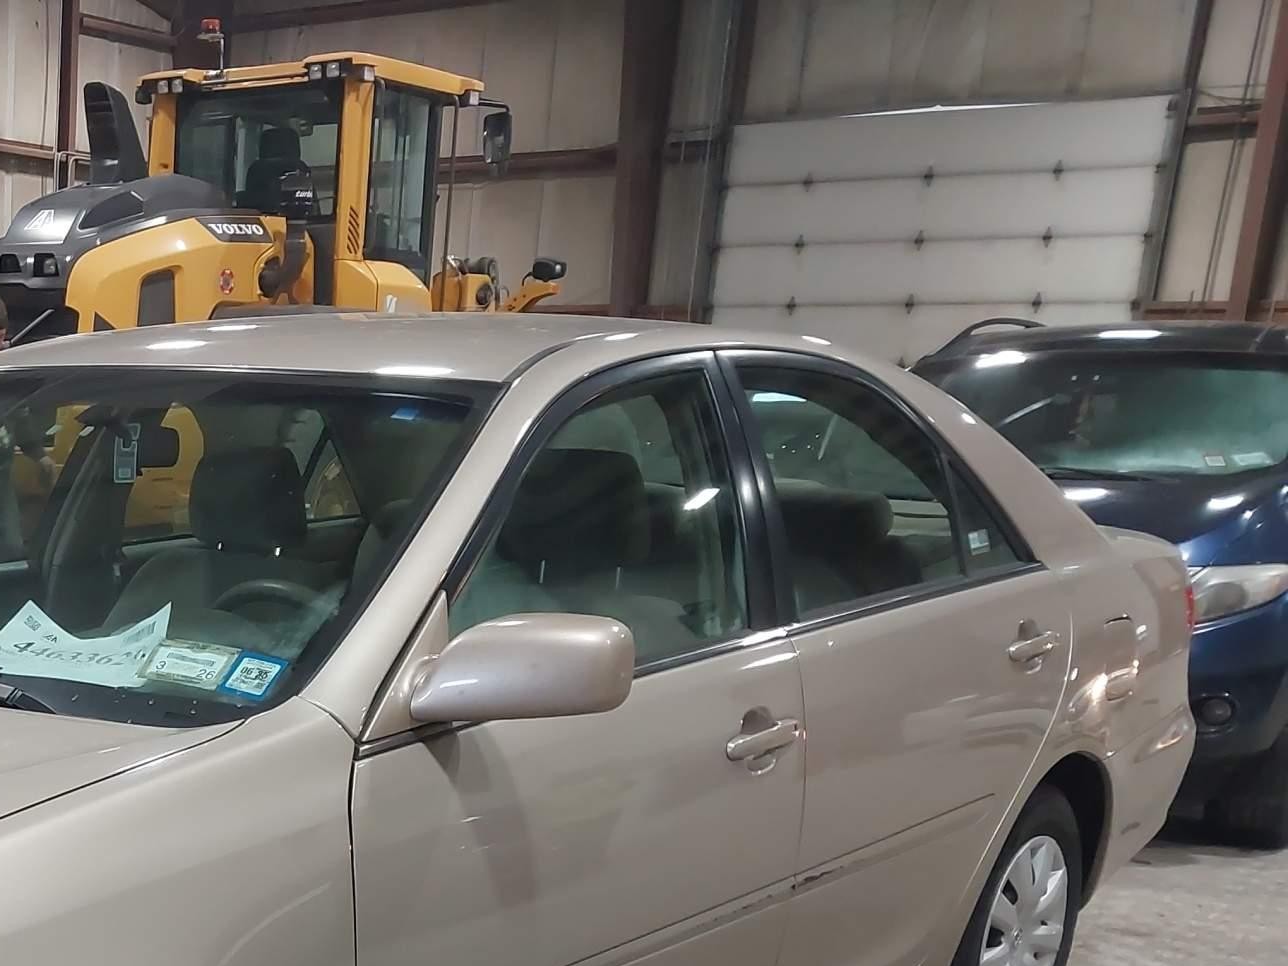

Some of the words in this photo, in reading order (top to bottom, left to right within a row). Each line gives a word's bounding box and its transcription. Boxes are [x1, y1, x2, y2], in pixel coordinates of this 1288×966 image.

[208, 223, 264, 235] VOLVO
[155, 660, 167, 670] 3
[196, 668, 216, 680] 26
